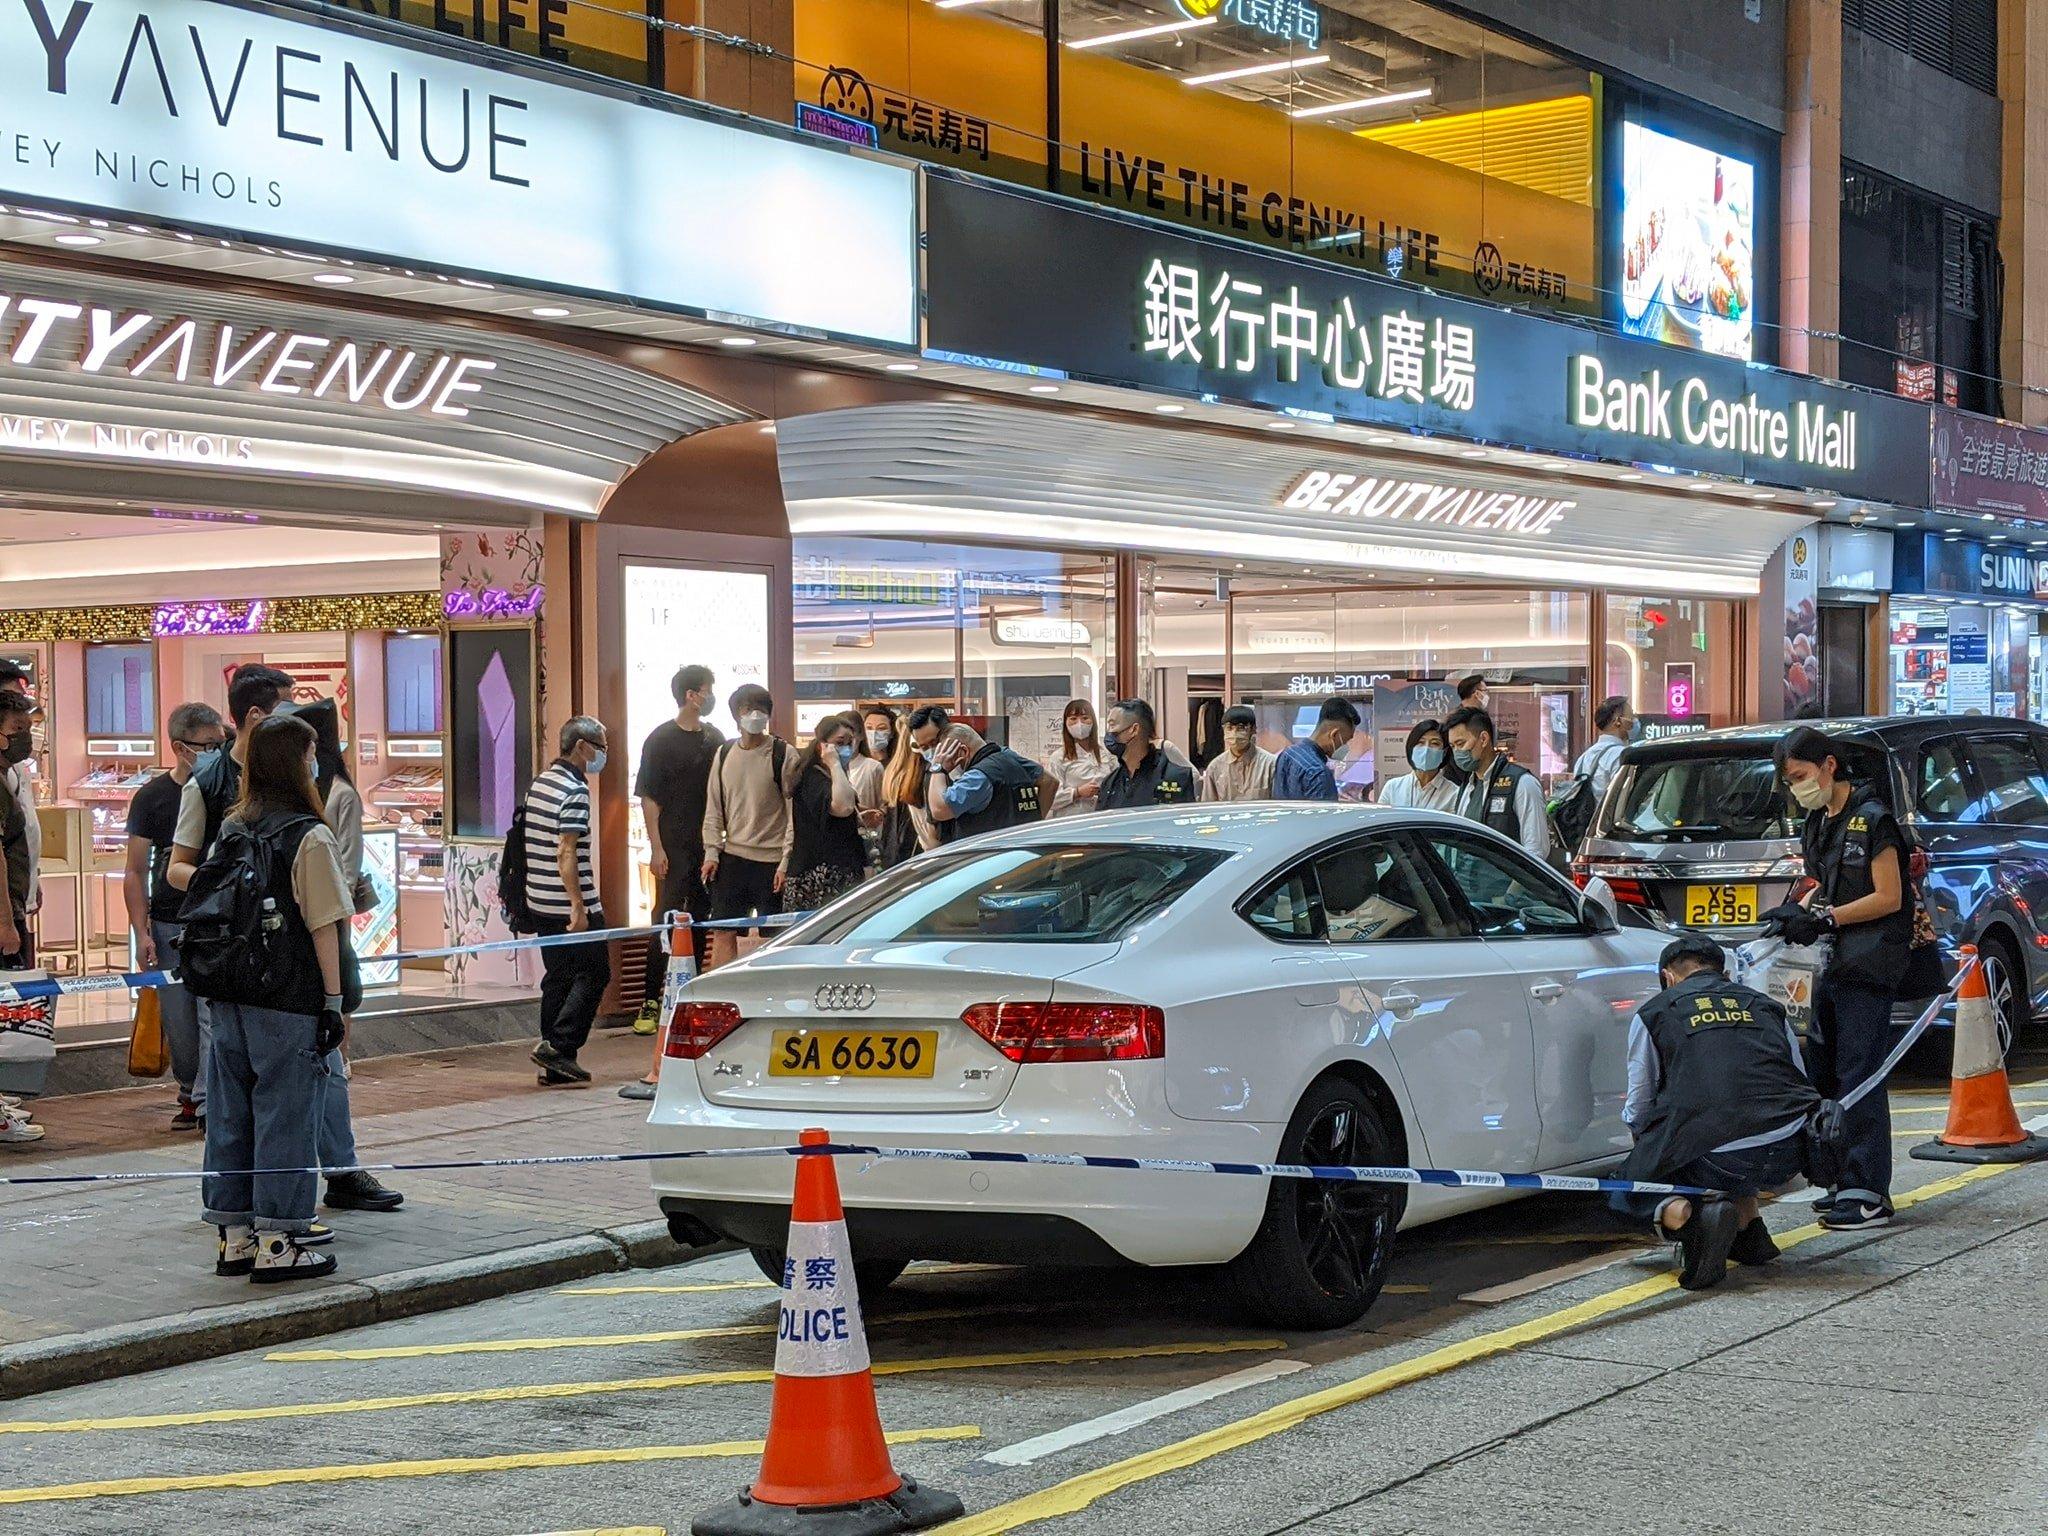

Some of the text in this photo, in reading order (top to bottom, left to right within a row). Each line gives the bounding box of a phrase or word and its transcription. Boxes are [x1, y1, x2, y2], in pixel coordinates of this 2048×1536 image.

[0, 131, 282, 207] EY NICHOLS
[1081, 142, 1440, 276] LIVE THE GENKI LIFE
[1144, 258, 1477, 412] 銀行中心廣場
[1578, 354, 1856, 470] Bank Centre Mall
[95, 424, 253, 459] NICHOLS
[1708, 886, 1736, 905] XS
[1692, 904, 1752, 923] 2599
[1690, 1011, 1754, 1028] POLICE
[782, 1036, 921, 1070] SA 6630
[1358, 1168, 1414, 1179] POLICE CORDON
